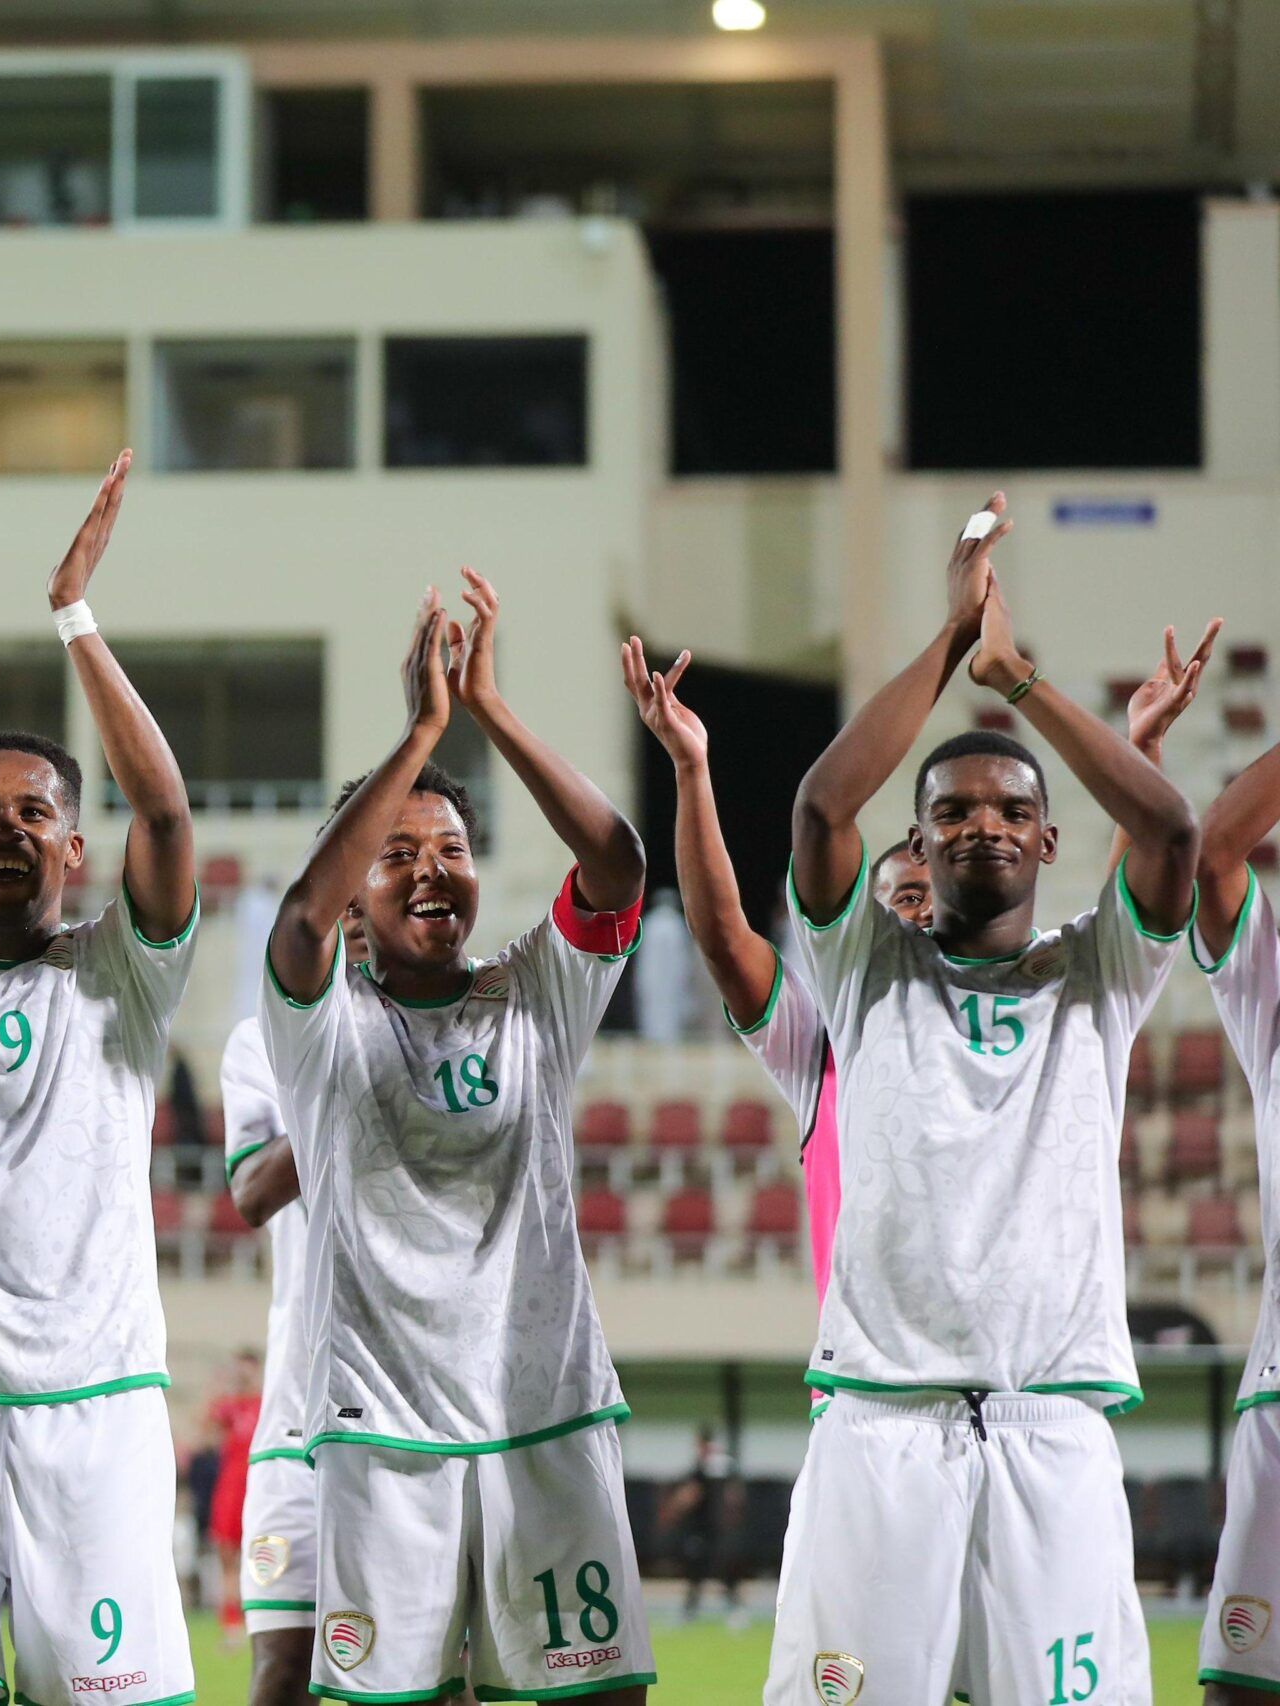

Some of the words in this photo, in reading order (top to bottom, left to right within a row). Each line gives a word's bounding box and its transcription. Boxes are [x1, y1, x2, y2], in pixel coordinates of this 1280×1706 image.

[959, 993, 1028, 1058] 15
[434, 1053, 499, 1114] 18
[90, 1597, 123, 1665] 9
[533, 1560, 619, 1649] 18
[72, 1671, 147, 1692] Kappa
[546, 1647, 621, 1669] Kappa
[1046, 1631, 1098, 1706] 15
